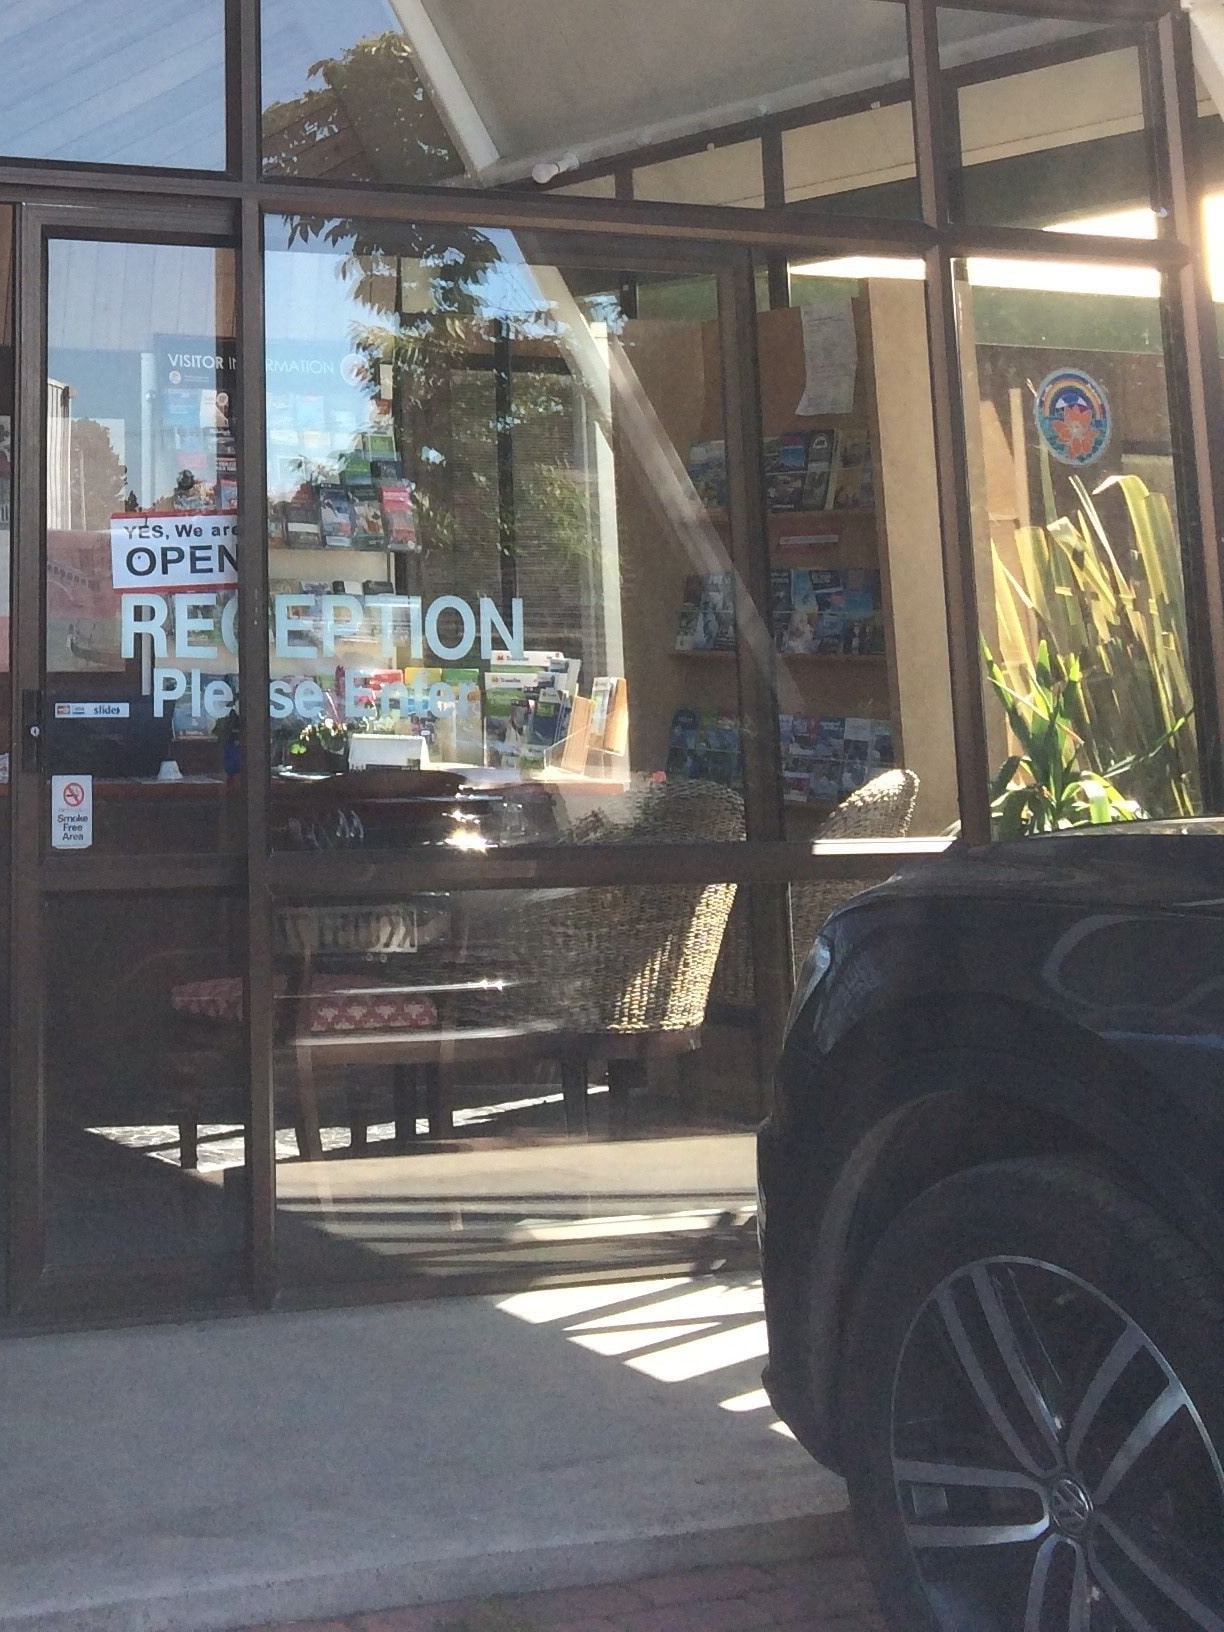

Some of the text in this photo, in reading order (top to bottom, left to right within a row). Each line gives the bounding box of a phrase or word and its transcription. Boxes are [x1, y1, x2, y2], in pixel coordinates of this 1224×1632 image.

[167, 353, 224, 370] VISITOR
[124, 524, 170, 540] YES,
[175, 523, 203, 538] We
[125, 544, 239, 576] OPEN
[153, 667, 482, 719] Plese Enter
[57, 814, 88, 823] Smoke
[62, 823, 83, 832] Free
[62, 832, 83, 841] Area
